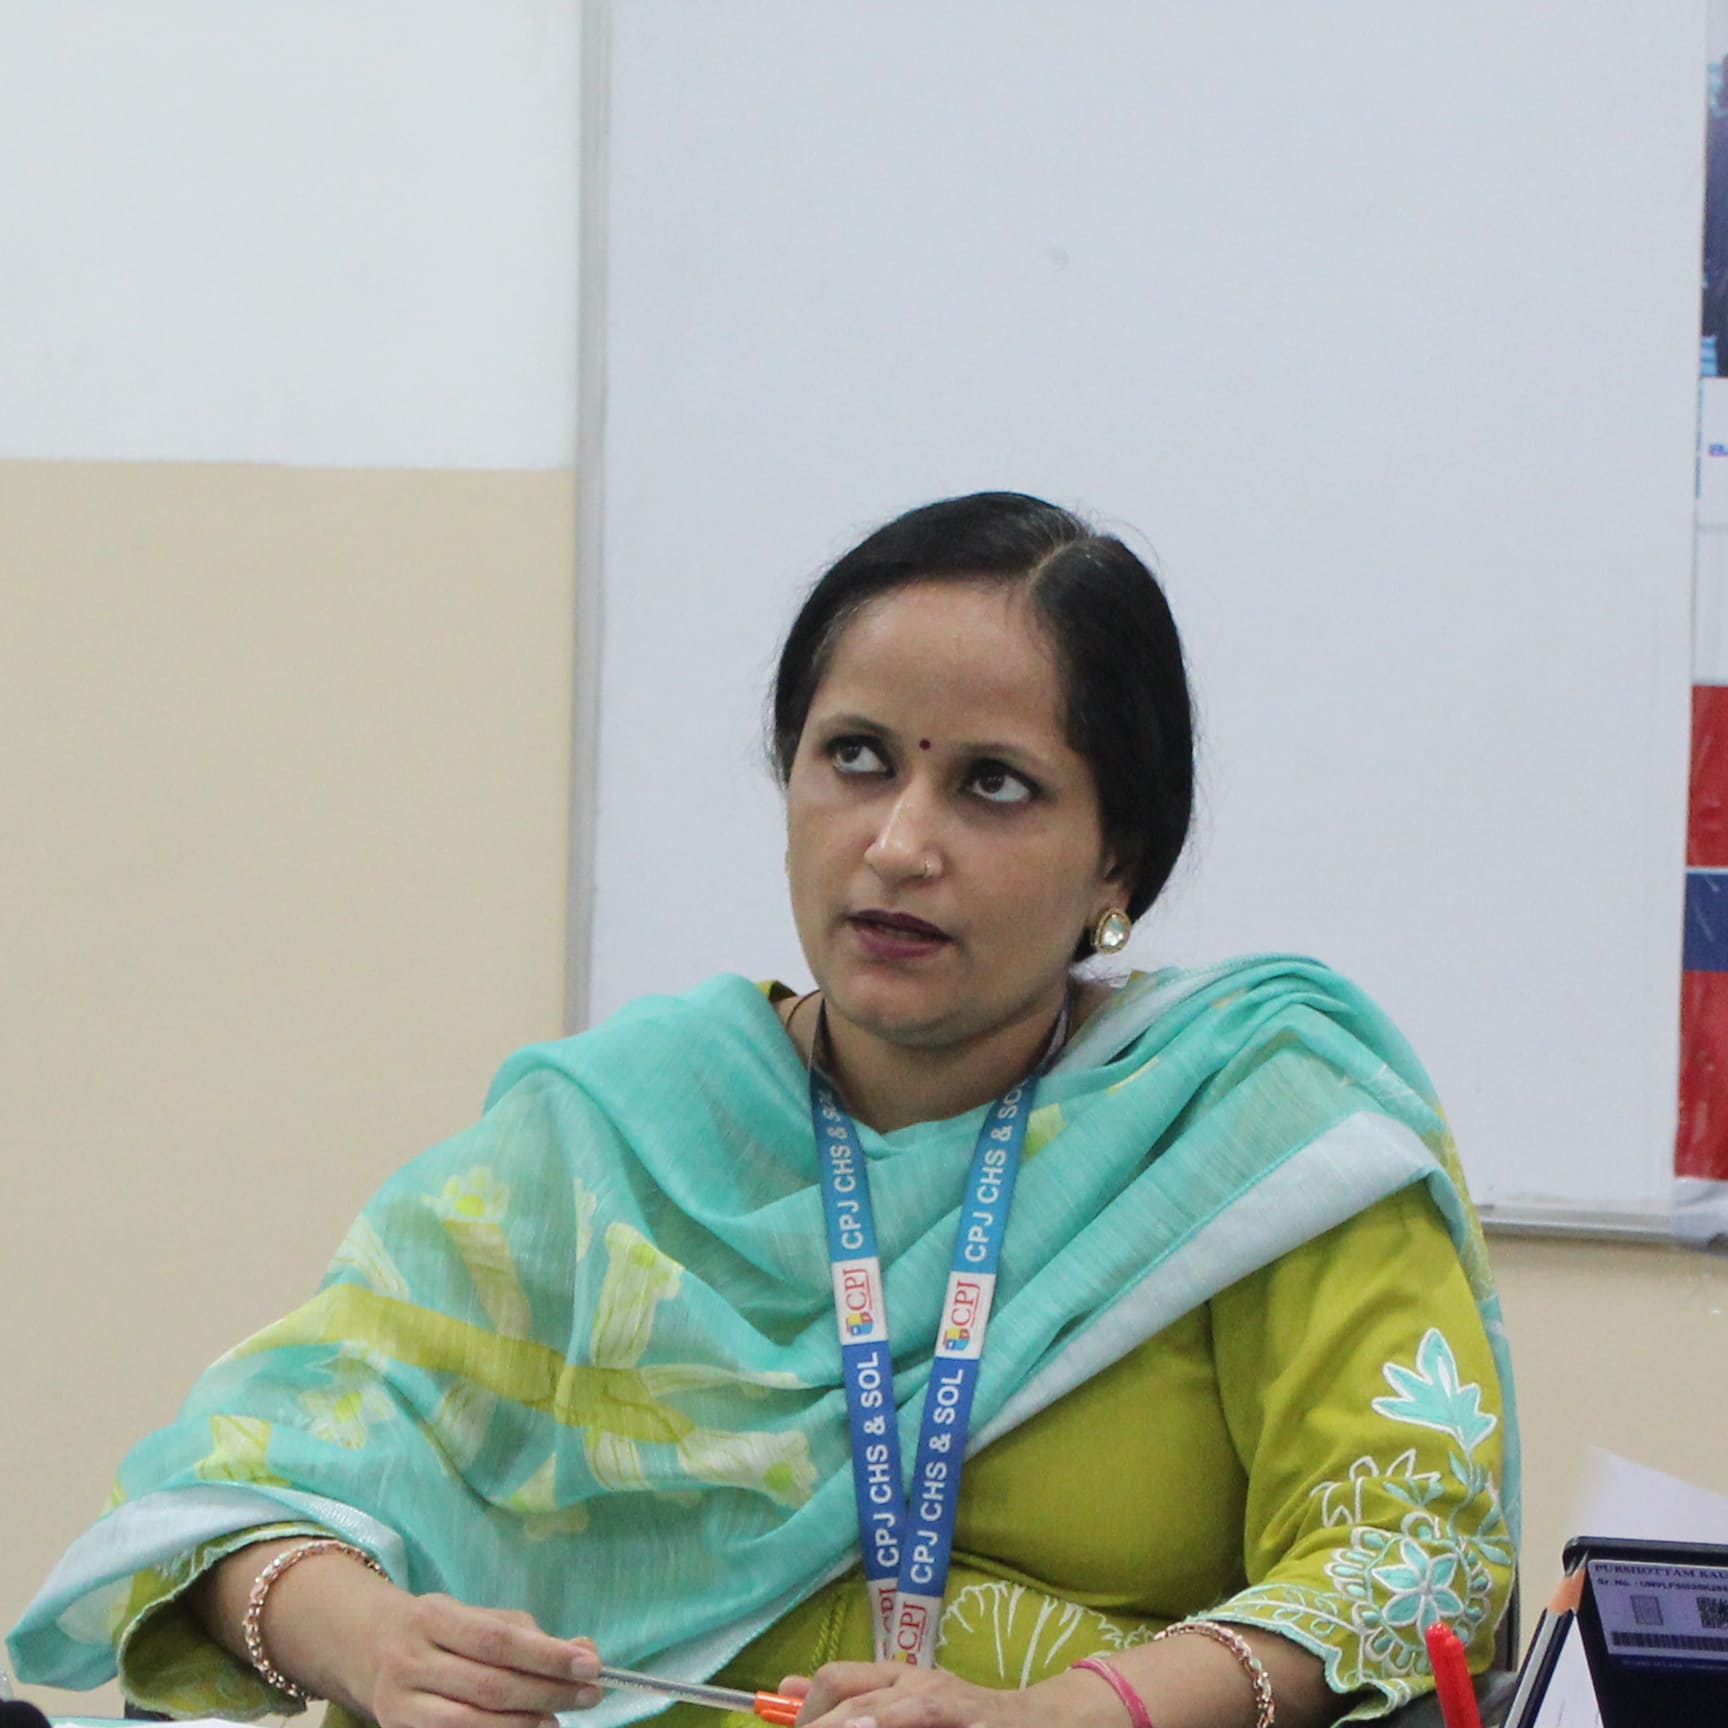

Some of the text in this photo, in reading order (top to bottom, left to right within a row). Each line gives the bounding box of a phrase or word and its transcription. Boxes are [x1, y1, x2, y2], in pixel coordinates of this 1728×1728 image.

[826, 1126, 849, 1141] &
[991, 1124, 1013, 1142] &
[829, 1143, 857, 1194] CHS
[977, 1148, 1007, 1205] CHS
[838, 1199, 865, 1251] CPJ
[964, 1210, 994, 1263] CPJ
[842, 1267, 869, 1312] CPJ
[951, 1280, 981, 1327] CPJ
[857, 1351, 900, 1568] CPJ CHS & SOL
[910, 1368, 964, 1585] CPJ CHS & SOL
[898, 1601, 928, 1652] CPJ
